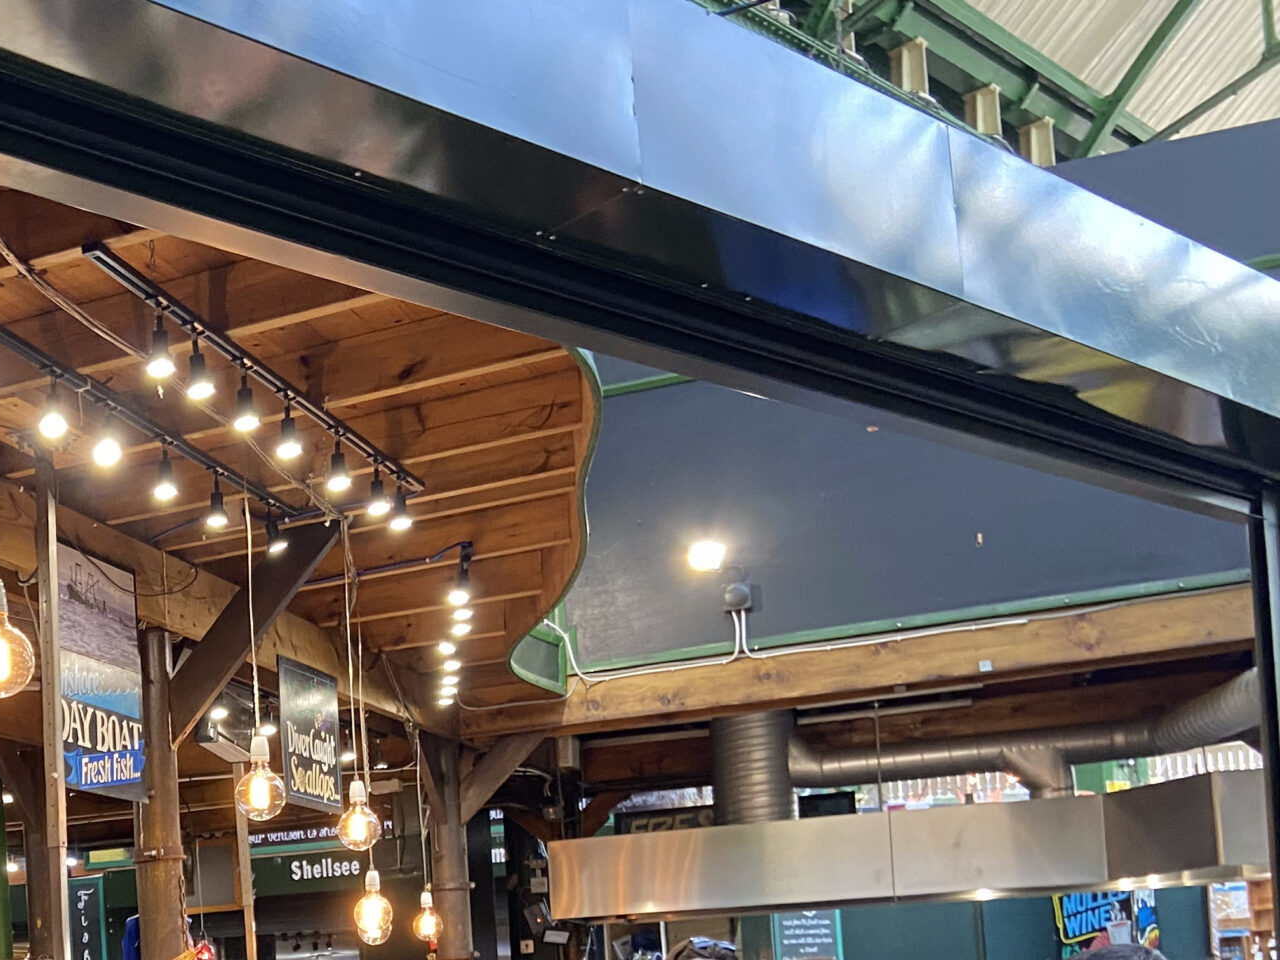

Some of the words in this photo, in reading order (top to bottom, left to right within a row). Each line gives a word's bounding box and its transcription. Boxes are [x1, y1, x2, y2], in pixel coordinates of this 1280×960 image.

[95, 709, 143, 752] BOAT
[286, 720, 310, 758] Diver
[310, 728, 337, 773] Caught
[81, 755, 112, 785] Fresh
[291, 857, 361, 881] Shellsee
[1064, 905, 1112, 938] WINE
